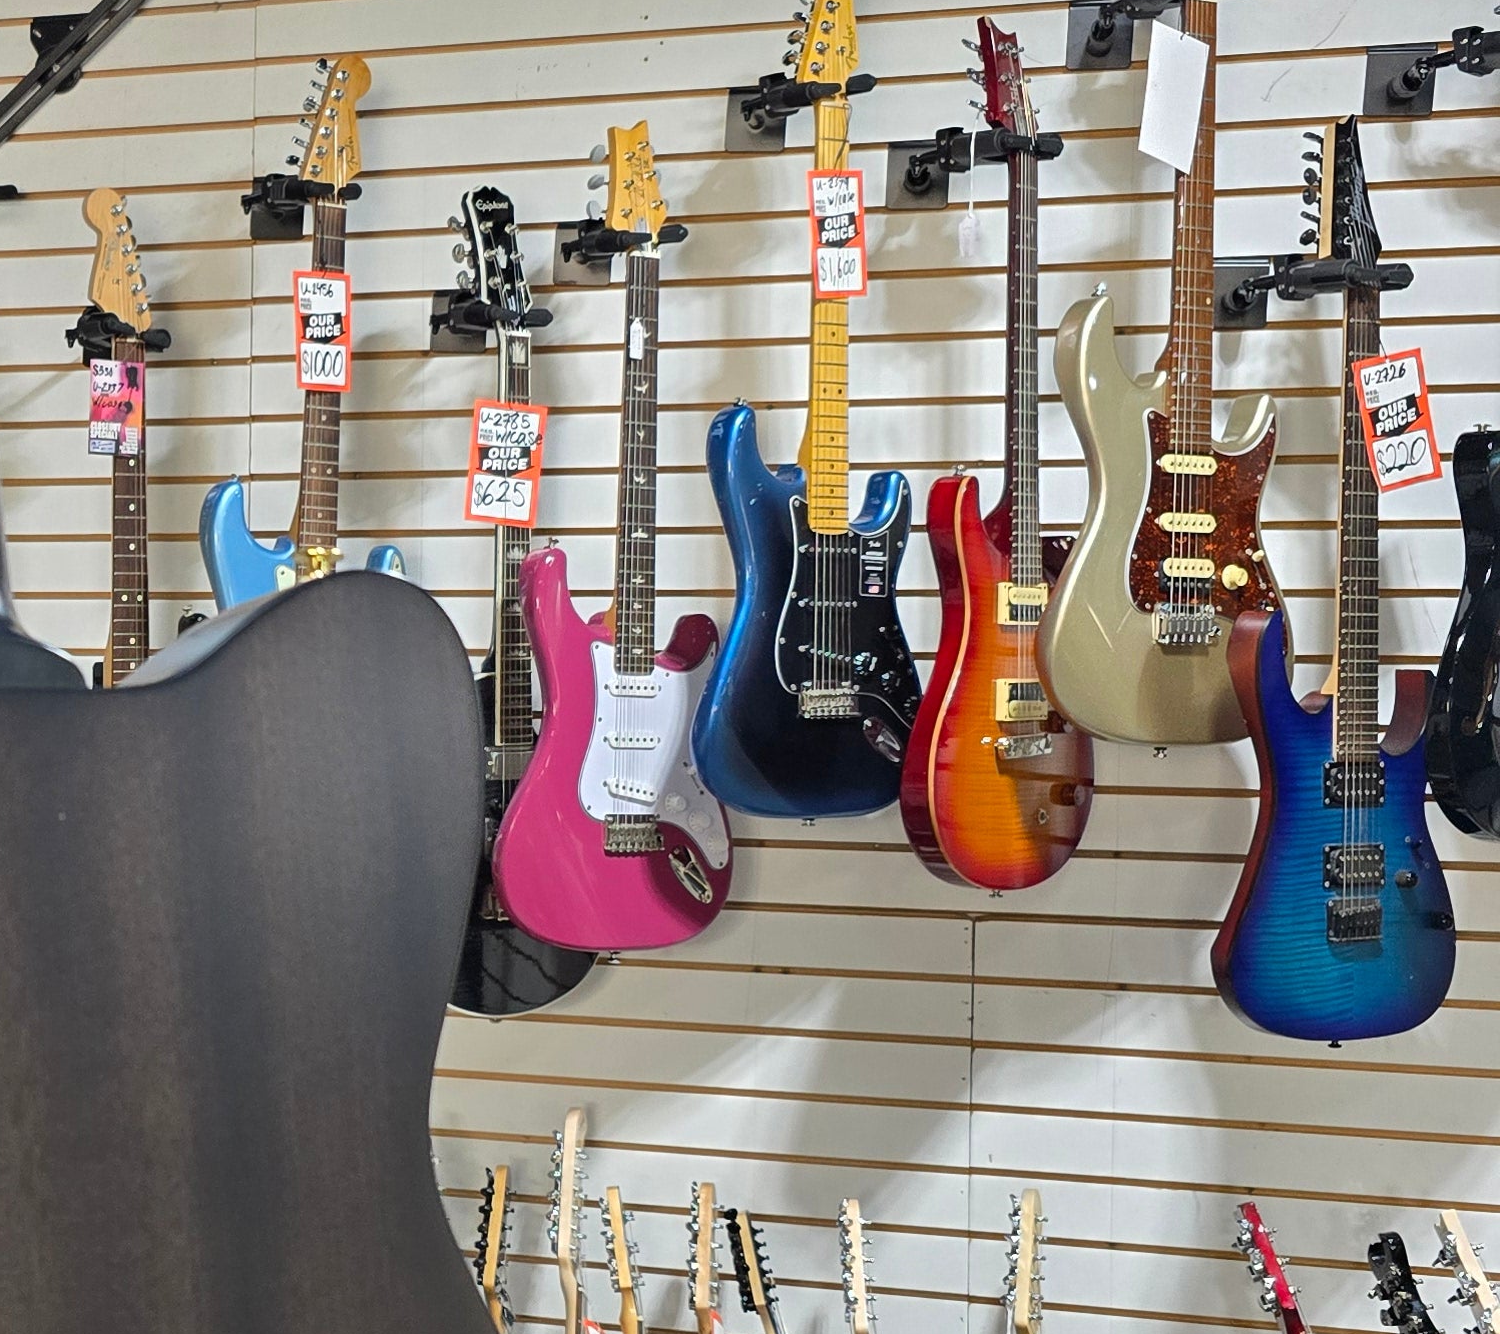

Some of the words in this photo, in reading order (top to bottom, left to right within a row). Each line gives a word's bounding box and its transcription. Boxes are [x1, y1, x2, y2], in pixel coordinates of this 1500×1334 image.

[475, 199, 509, 212] Epiphone
[824, 215, 849, 230] OUR
[821, 225, 856, 244] PRICE
[309, 314, 335, 327] OUR
[305, 324, 341, 339] PRICE
[302, 350, 343, 380] $1000
[1378, 398, 1408, 419] OUR
[1375, 407, 1417, 436] PRICE
[488, 447, 521, 459] OUR
[481, 457, 528, 471] PRICE
[474, 479, 526, 507] $625
